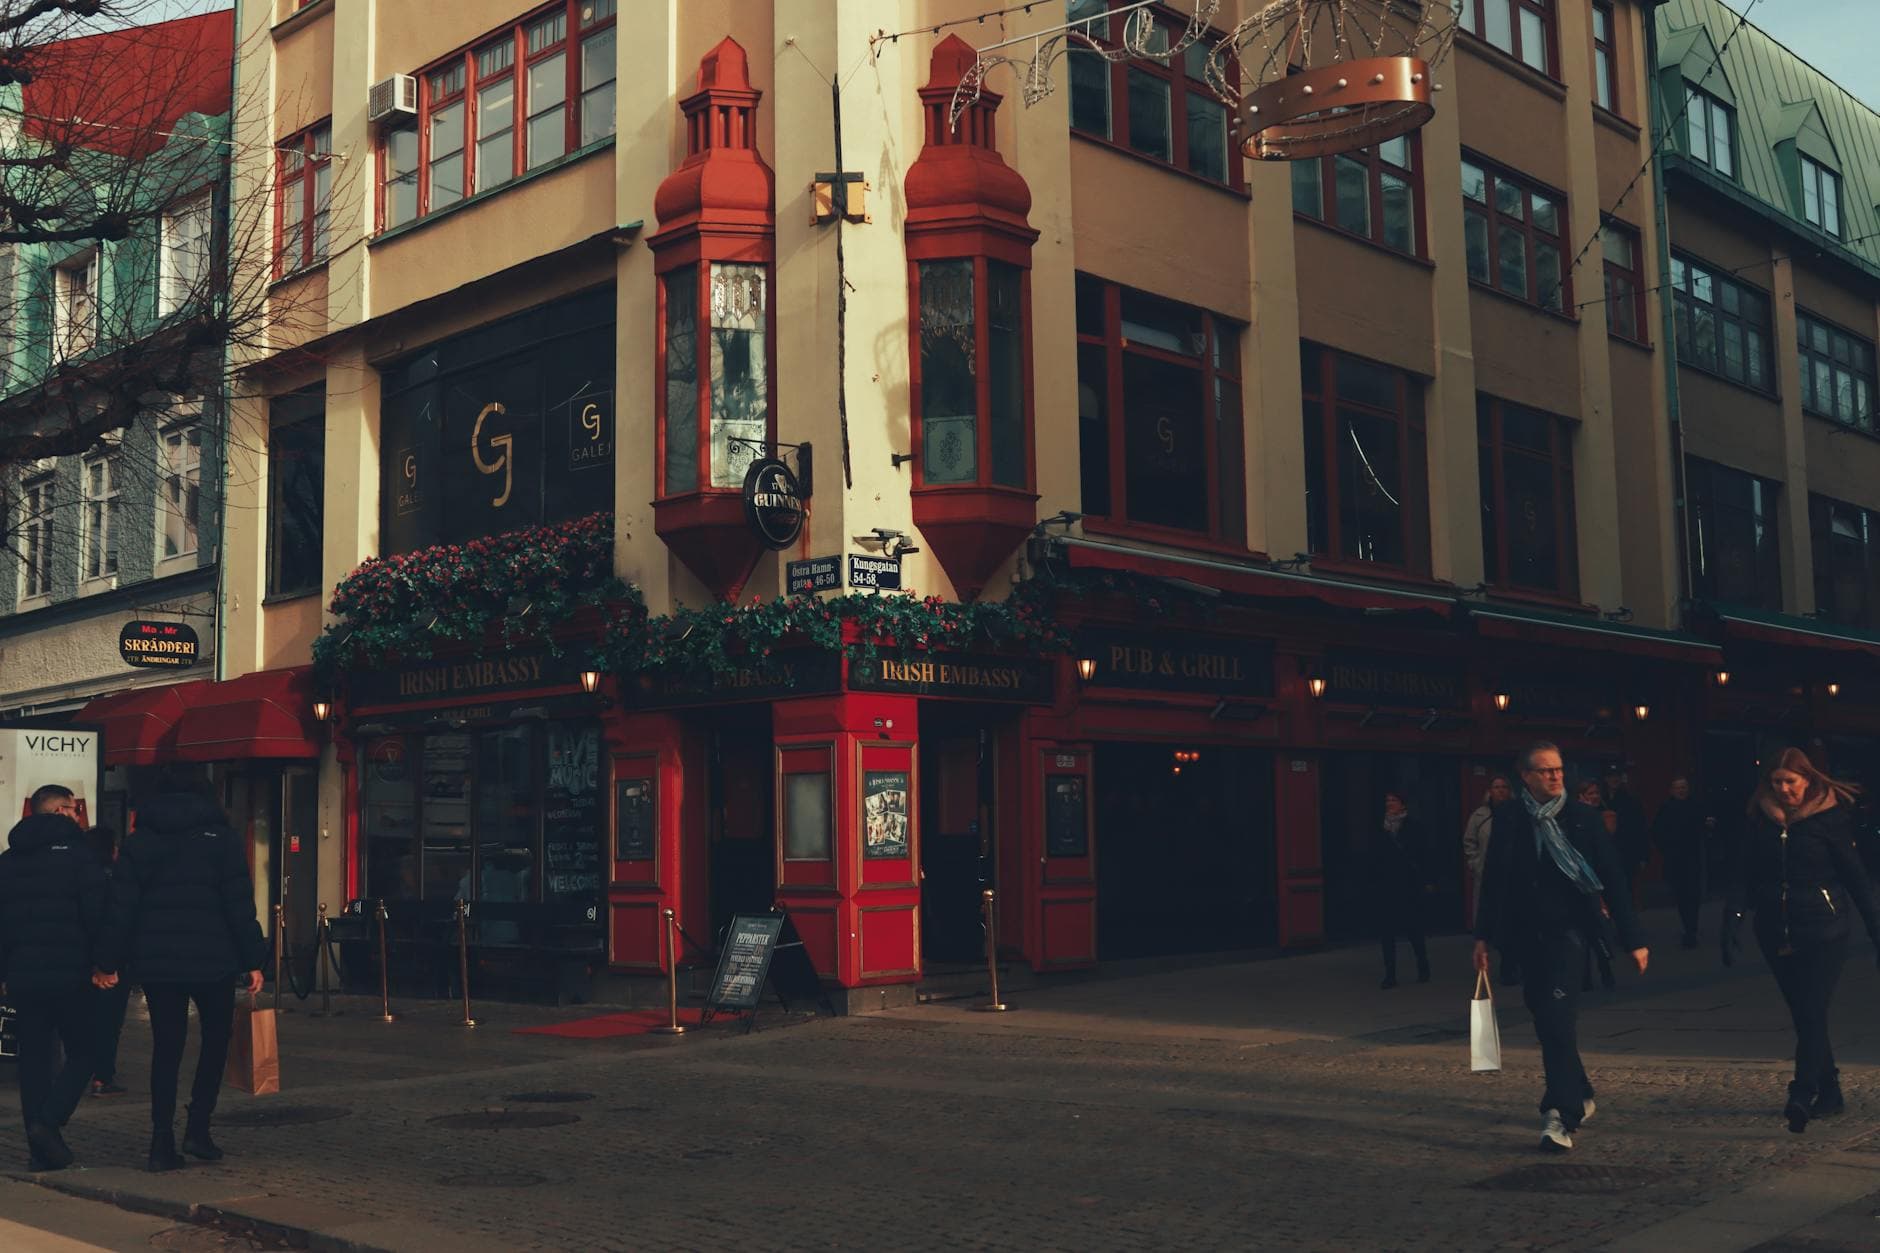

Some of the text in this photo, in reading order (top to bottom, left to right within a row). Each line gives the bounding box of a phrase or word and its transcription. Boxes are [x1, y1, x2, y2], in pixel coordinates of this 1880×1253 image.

[811, 563, 834, 574] Hamn-
[853, 558, 898, 573] Kungsgatan
[815, 573, 835, 586] 46-50
[853, 572, 876, 585] 54-58
[124, 637, 195, 654] SKRÄDDERI
[1111, 646, 1246, 681] PUB & GRILL
[400, 655, 544, 695] IRISH EMBASSY
[881, 659, 1023, 689] IRISH EMBASSY
[26, 735, 90, 752] VICHY
